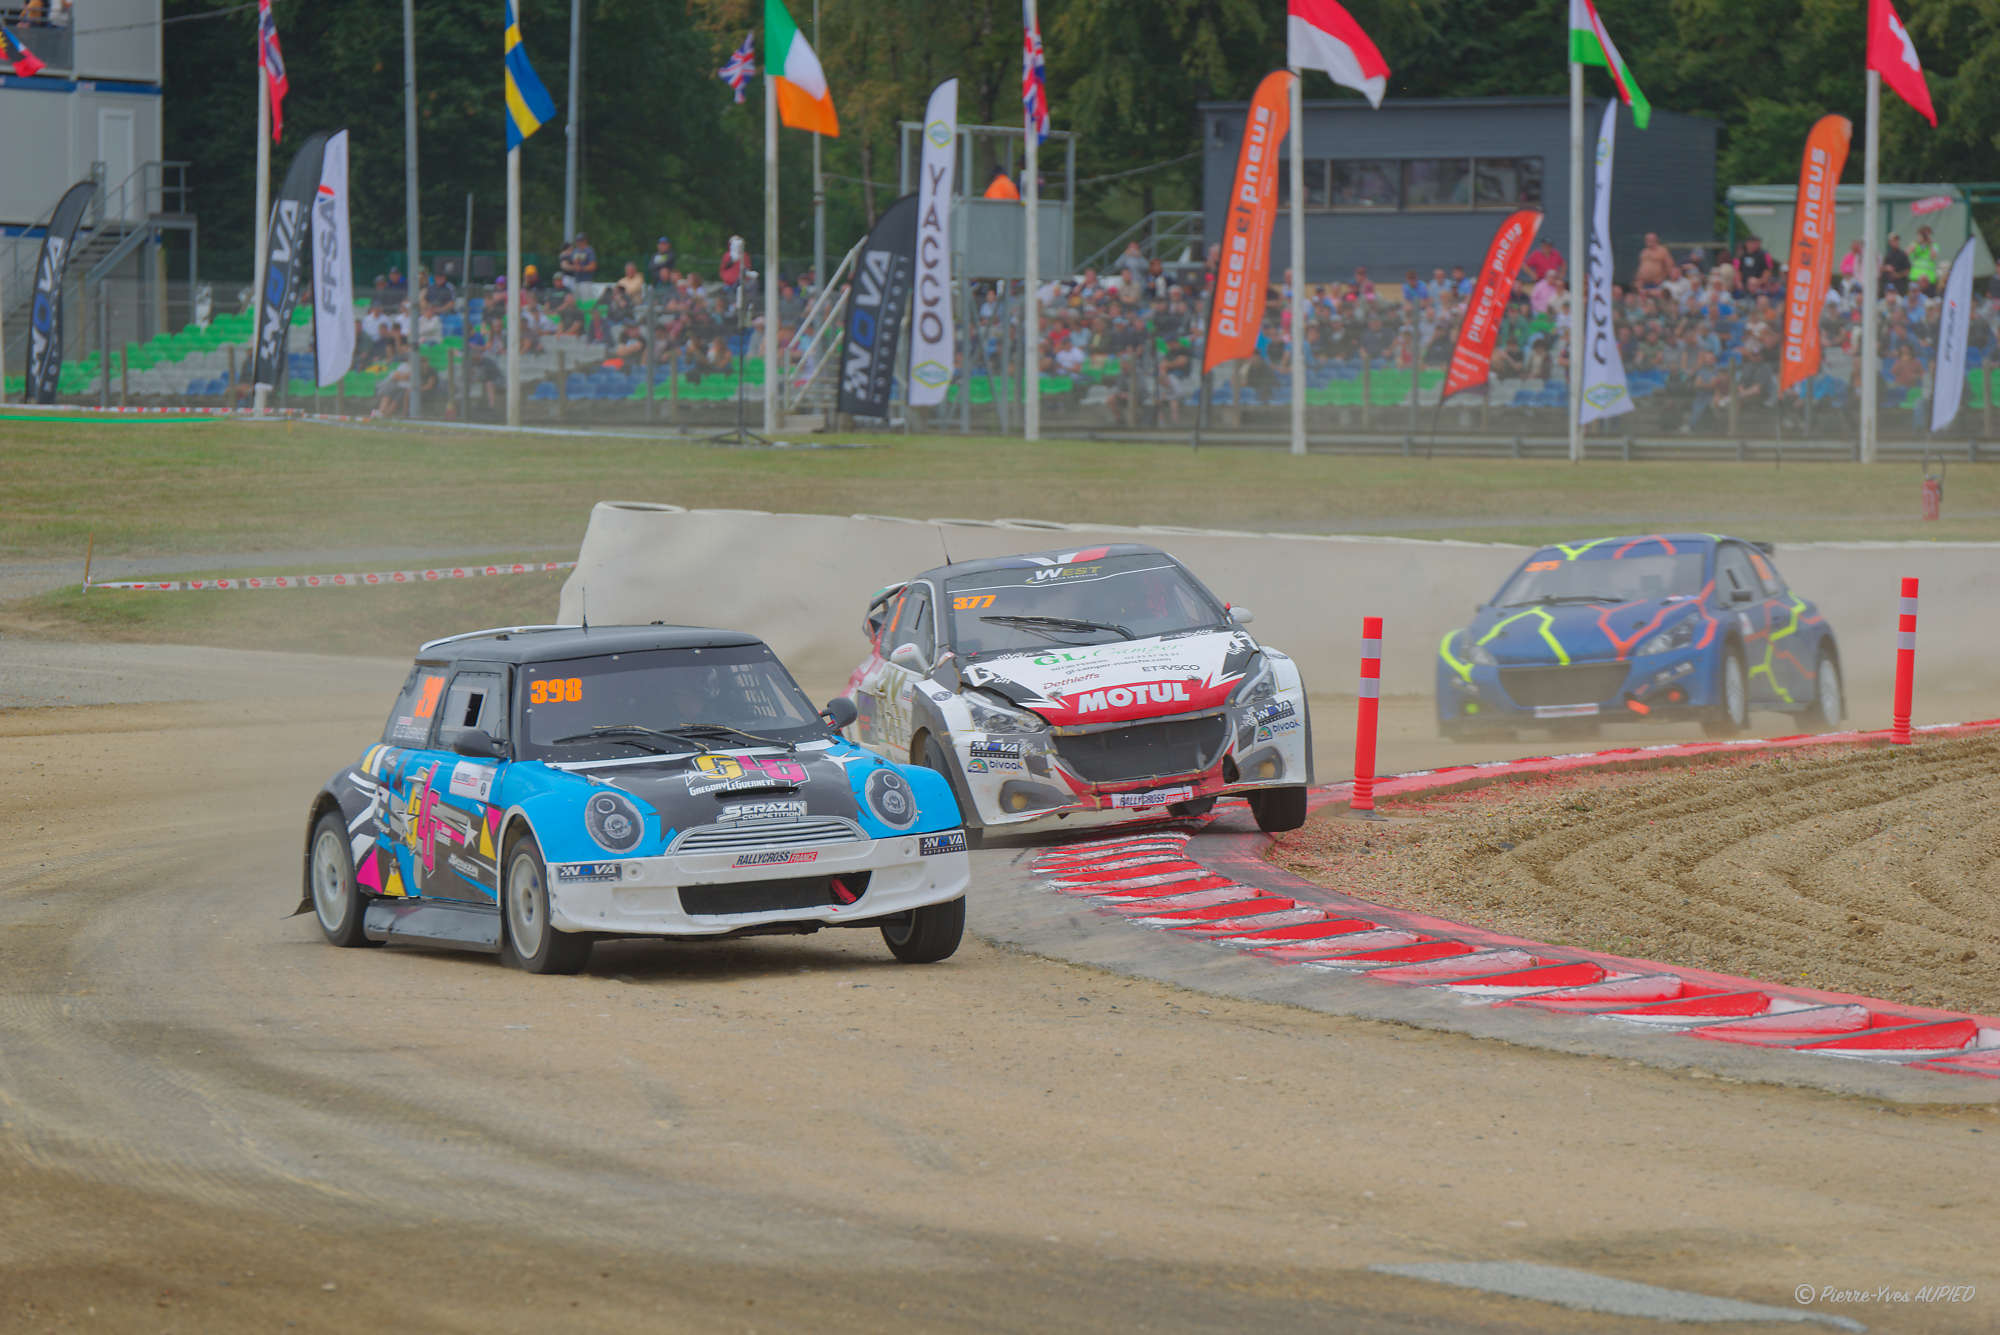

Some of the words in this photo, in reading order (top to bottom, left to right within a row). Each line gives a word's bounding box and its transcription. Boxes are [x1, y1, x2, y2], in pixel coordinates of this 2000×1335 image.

[317, 200, 337, 315] FFSA
[920, 163, 946, 344] YACCO
[845, 251, 892, 384] NOVA
[1034, 566, 1103, 580] WEST
[953, 594, 997, 610] 377
[1034, 653, 1087, 666] GL
[530, 677, 582, 704] 398
[1077, 682, 1190, 714] MOTUL
[718, 801, 807, 821] SERAZIN
[742, 811, 801, 820] COMPETITION
[926, 834, 963, 848] NOVA
[736, 851, 791, 865] RALLYCROSS
[564, 863, 617, 877] NOVA
